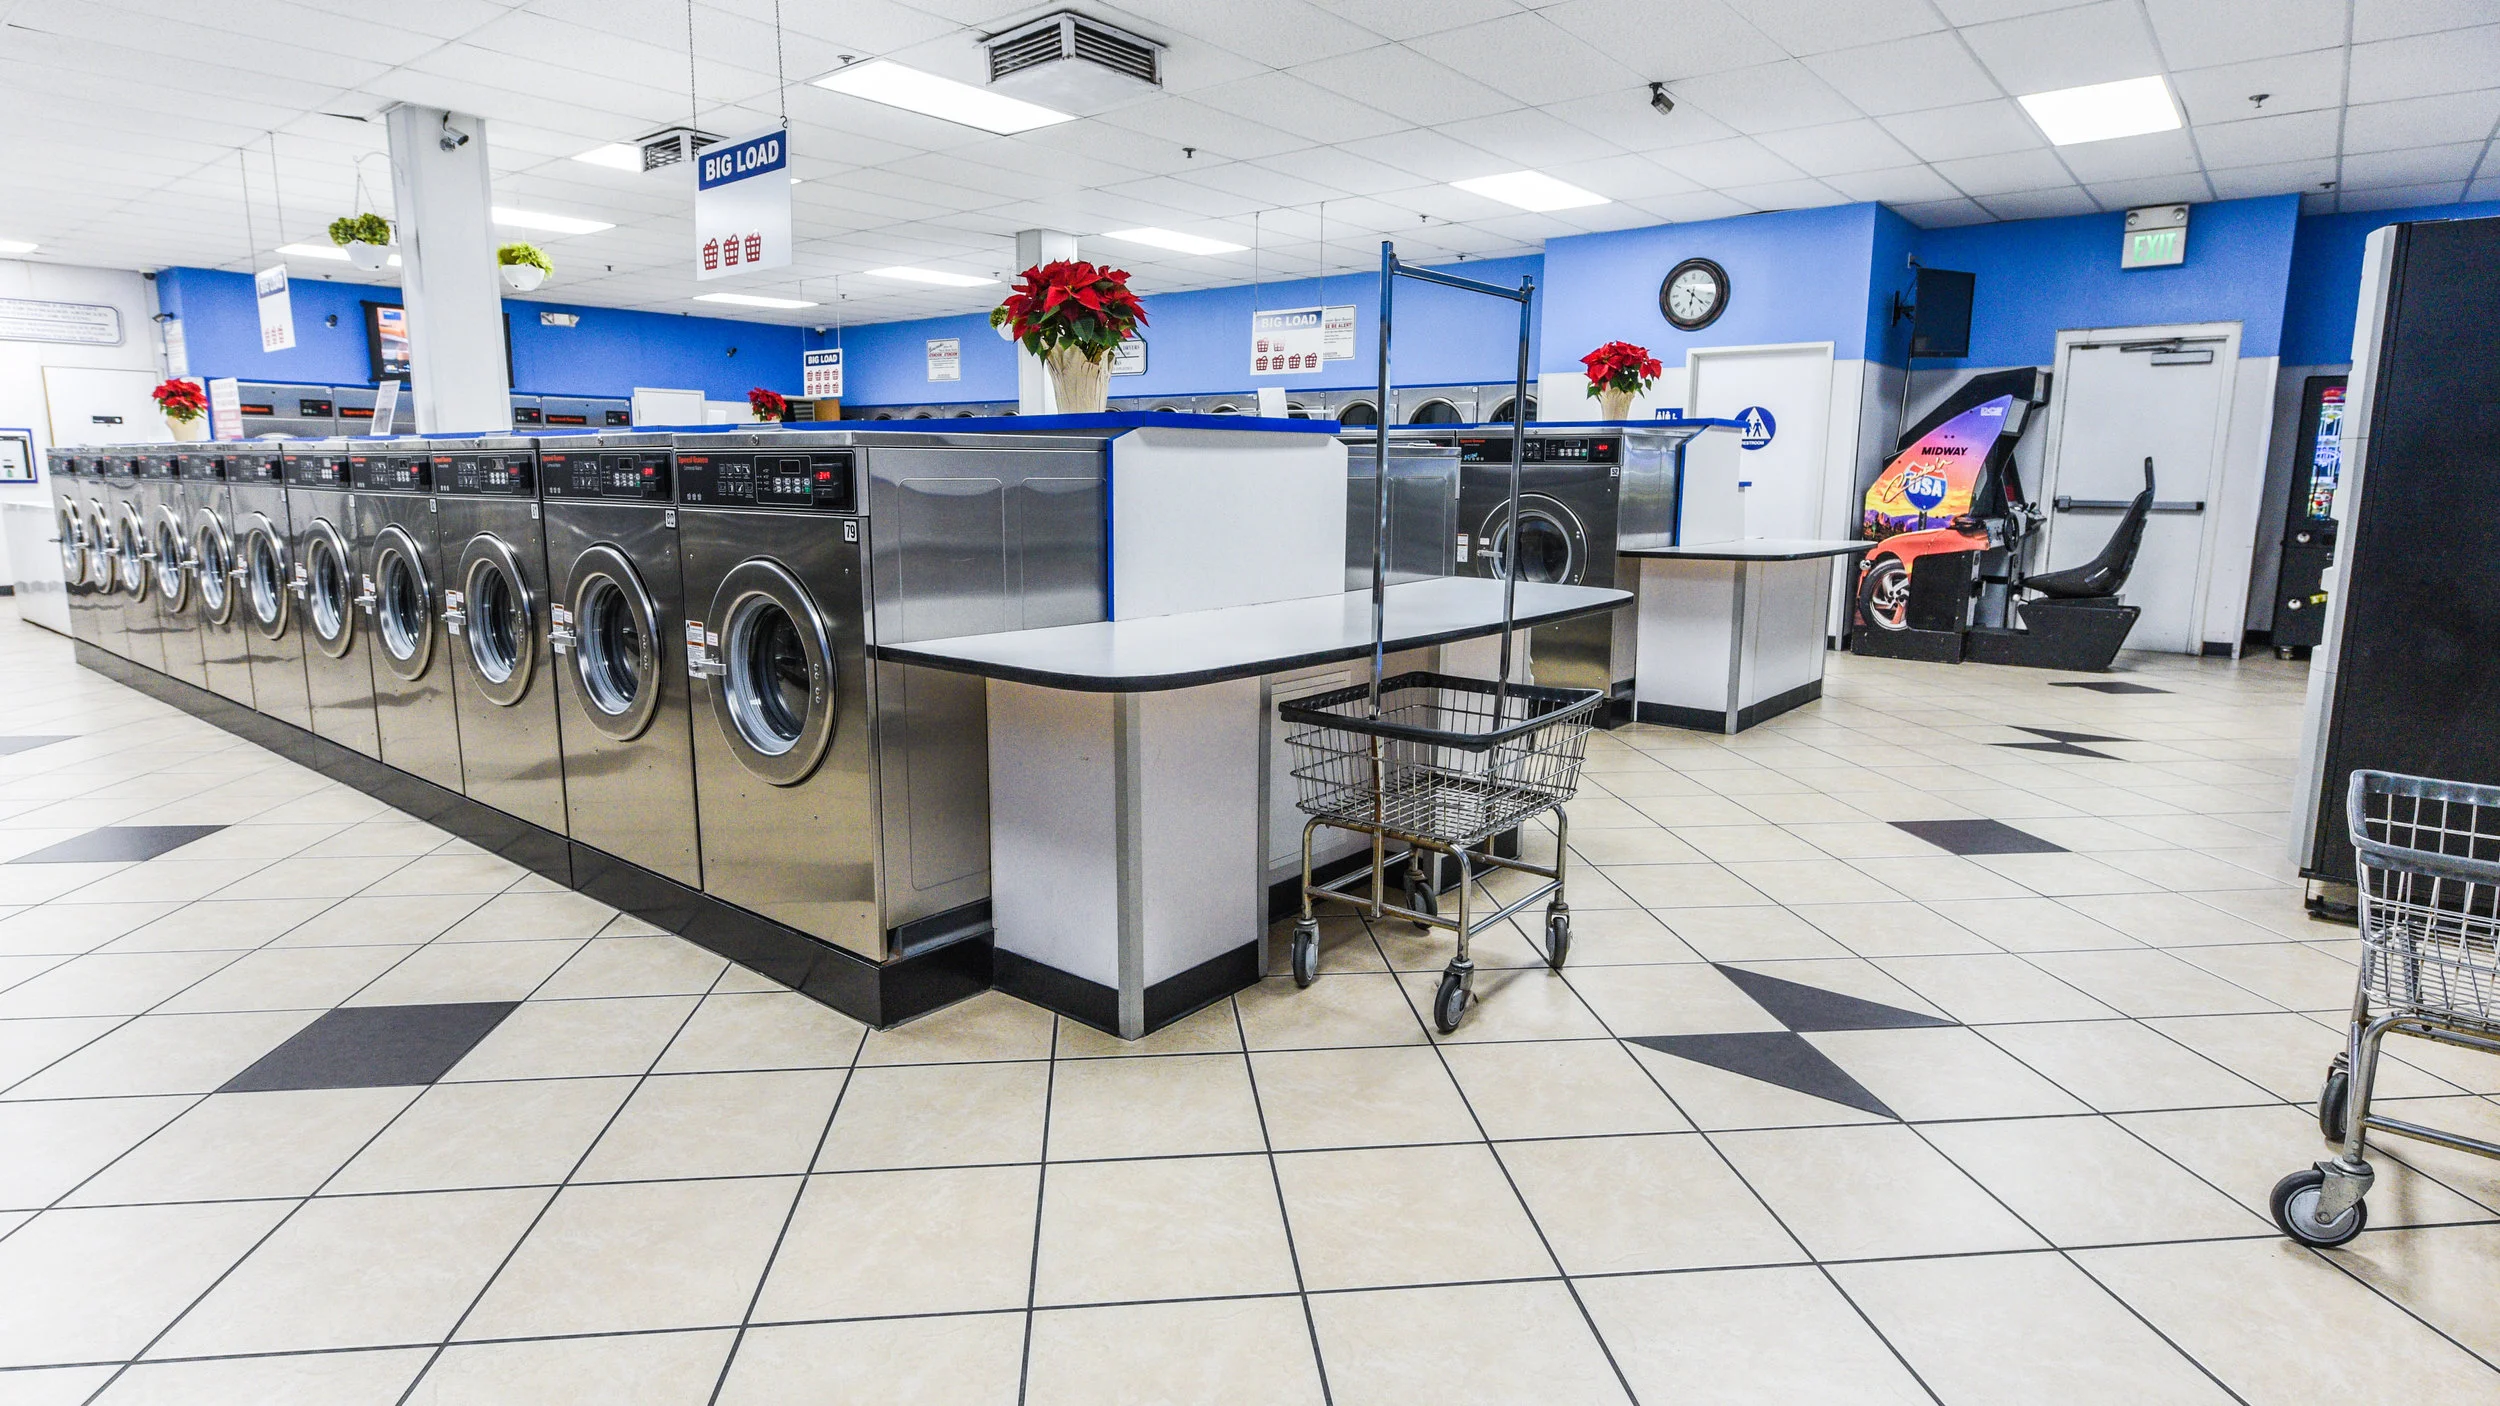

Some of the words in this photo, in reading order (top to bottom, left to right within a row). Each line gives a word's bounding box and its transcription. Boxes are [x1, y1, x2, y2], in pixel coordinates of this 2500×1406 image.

[705, 154, 732, 182] BIG
[736, 139, 779, 173] LOAD
[2134, 232, 2177, 263] EXIT
[1262, 317, 1282, 328] BIG
[1285, 314, 1317, 326] LOAD
[808, 355, 819, 364] BIG
[820, 354, 837, 363] LOAD
[1921, 446, 1968, 456] MIDWAY
[1908, 477, 1943, 498] USA
[845, 524, 856, 539] 79
